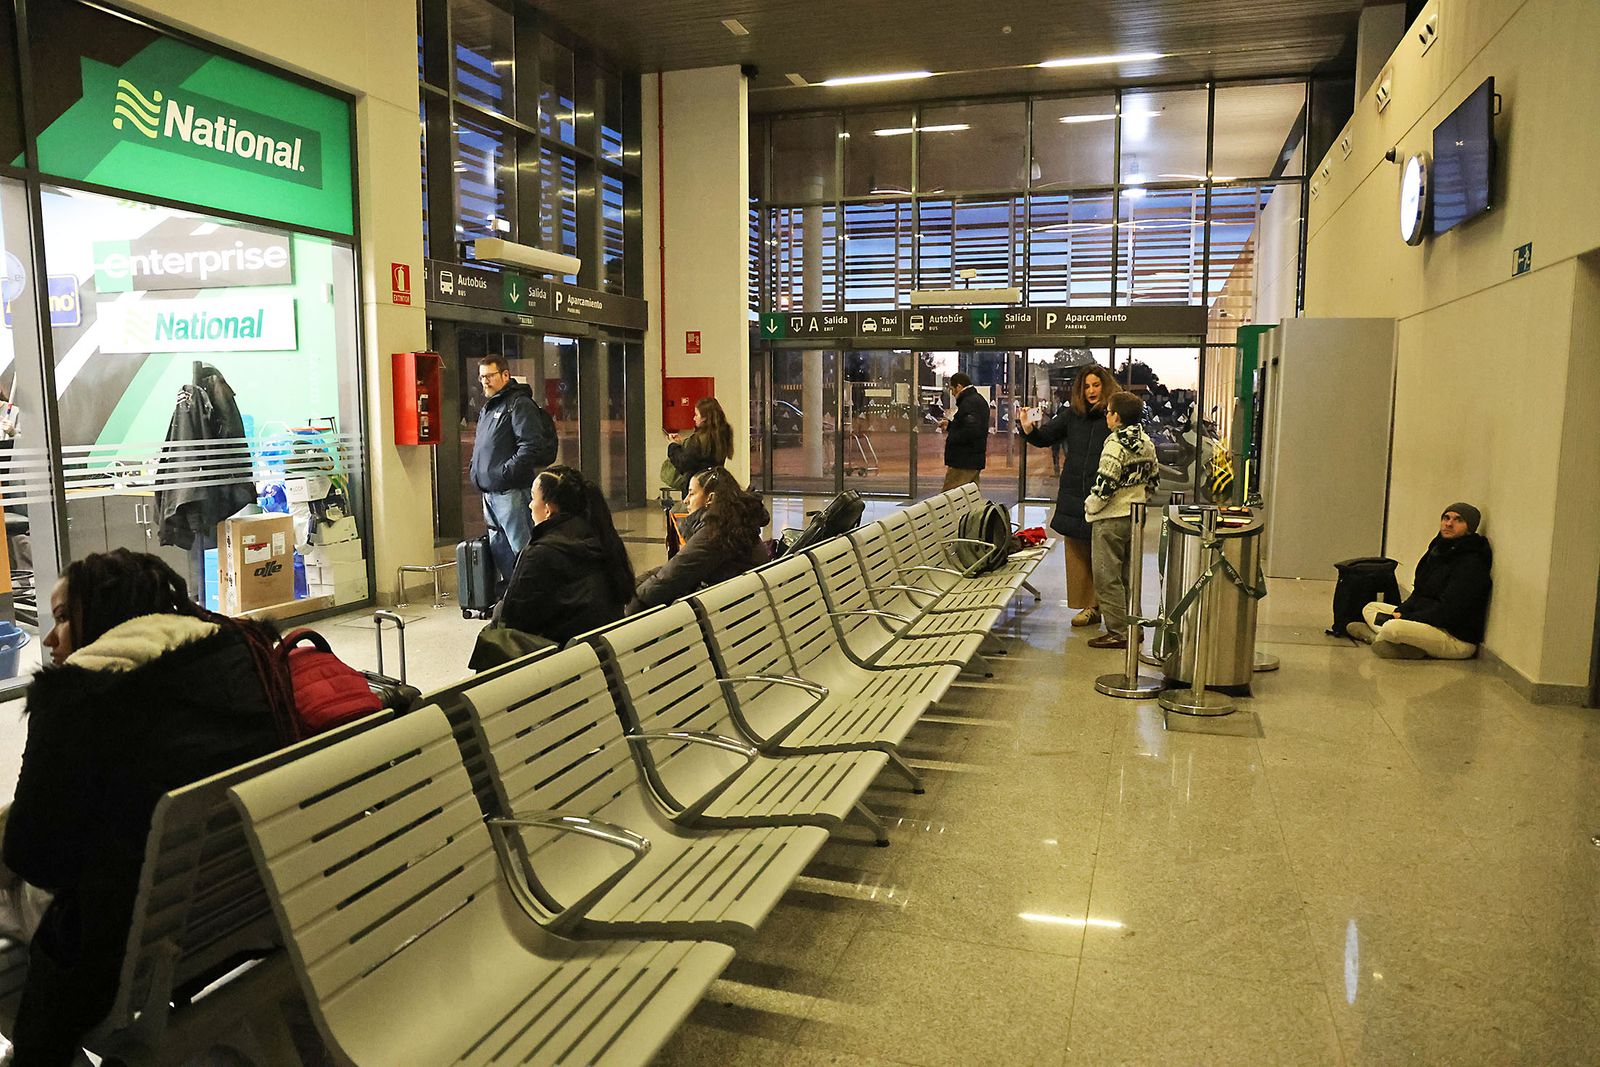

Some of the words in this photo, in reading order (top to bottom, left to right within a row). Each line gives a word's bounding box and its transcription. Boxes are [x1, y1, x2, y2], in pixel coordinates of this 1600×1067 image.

[103, 240, 288, 280] enterprise
[457, 274, 487, 289] Autobús
[528, 287, 547, 299] Salida
[567, 294, 603, 310] Aparcamiento
[155, 308, 264, 341] National
[808, 317, 819, 332] A
[824, 316, 848, 325] Salida
[881, 316, 897, 325] Taxi
[929, 313, 963, 323] Autobús
[1005, 313, 1031, 322] Salida
[1046, 313, 1057, 329] P
[1065, 313, 1127, 323] Aparcamiento
